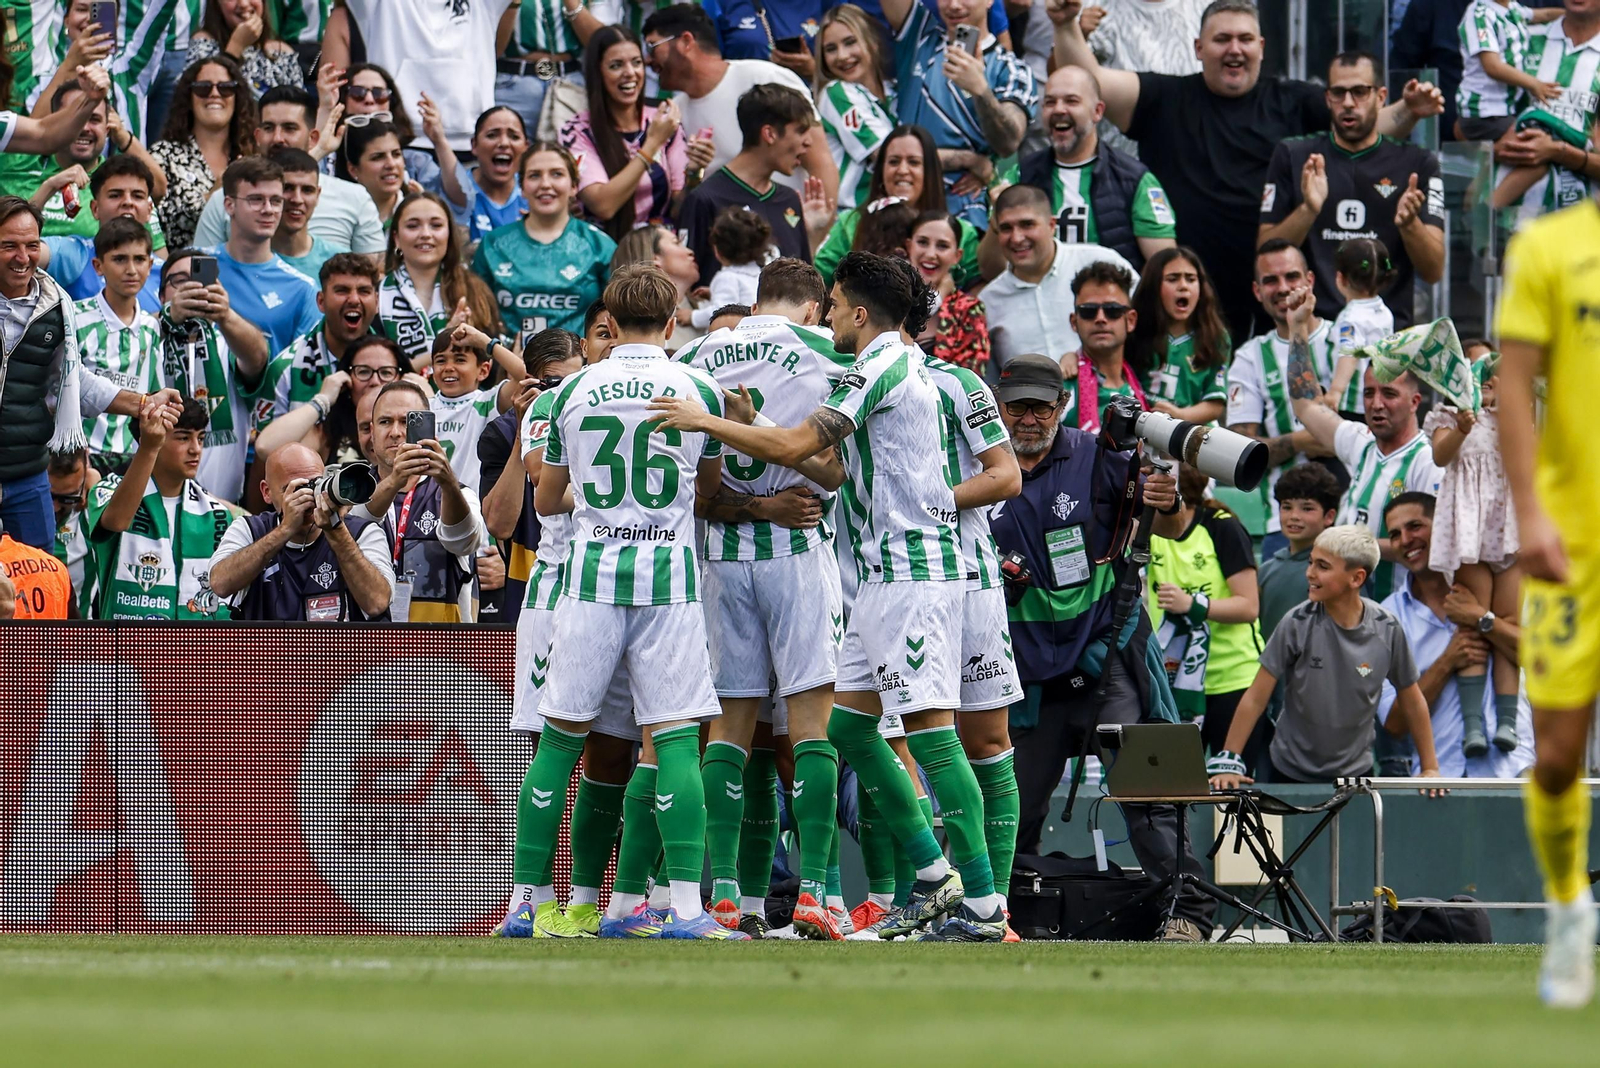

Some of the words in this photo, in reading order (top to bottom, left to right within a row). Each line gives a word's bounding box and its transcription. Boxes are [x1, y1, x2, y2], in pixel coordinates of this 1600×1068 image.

[515, 293, 580, 309] GREE
[588, 377, 654, 407] JESÚS
[437, 421, 465, 433] TONY
[579, 416, 682, 509] 36
[1126, 481, 1136, 499] EOS
[608, 524, 676, 541] rainline
[16, 587, 45, 613] 10
[117, 591, 171, 609] RealBetis
[976, 661, 999, 672] AUS
[881, 672, 900, 683] AUS
[962, 668, 1008, 683] GLOBAL
[877, 679, 909, 693] LOBAL
[345, 720, 503, 808] EA
[523, 887, 533, 901] GU
